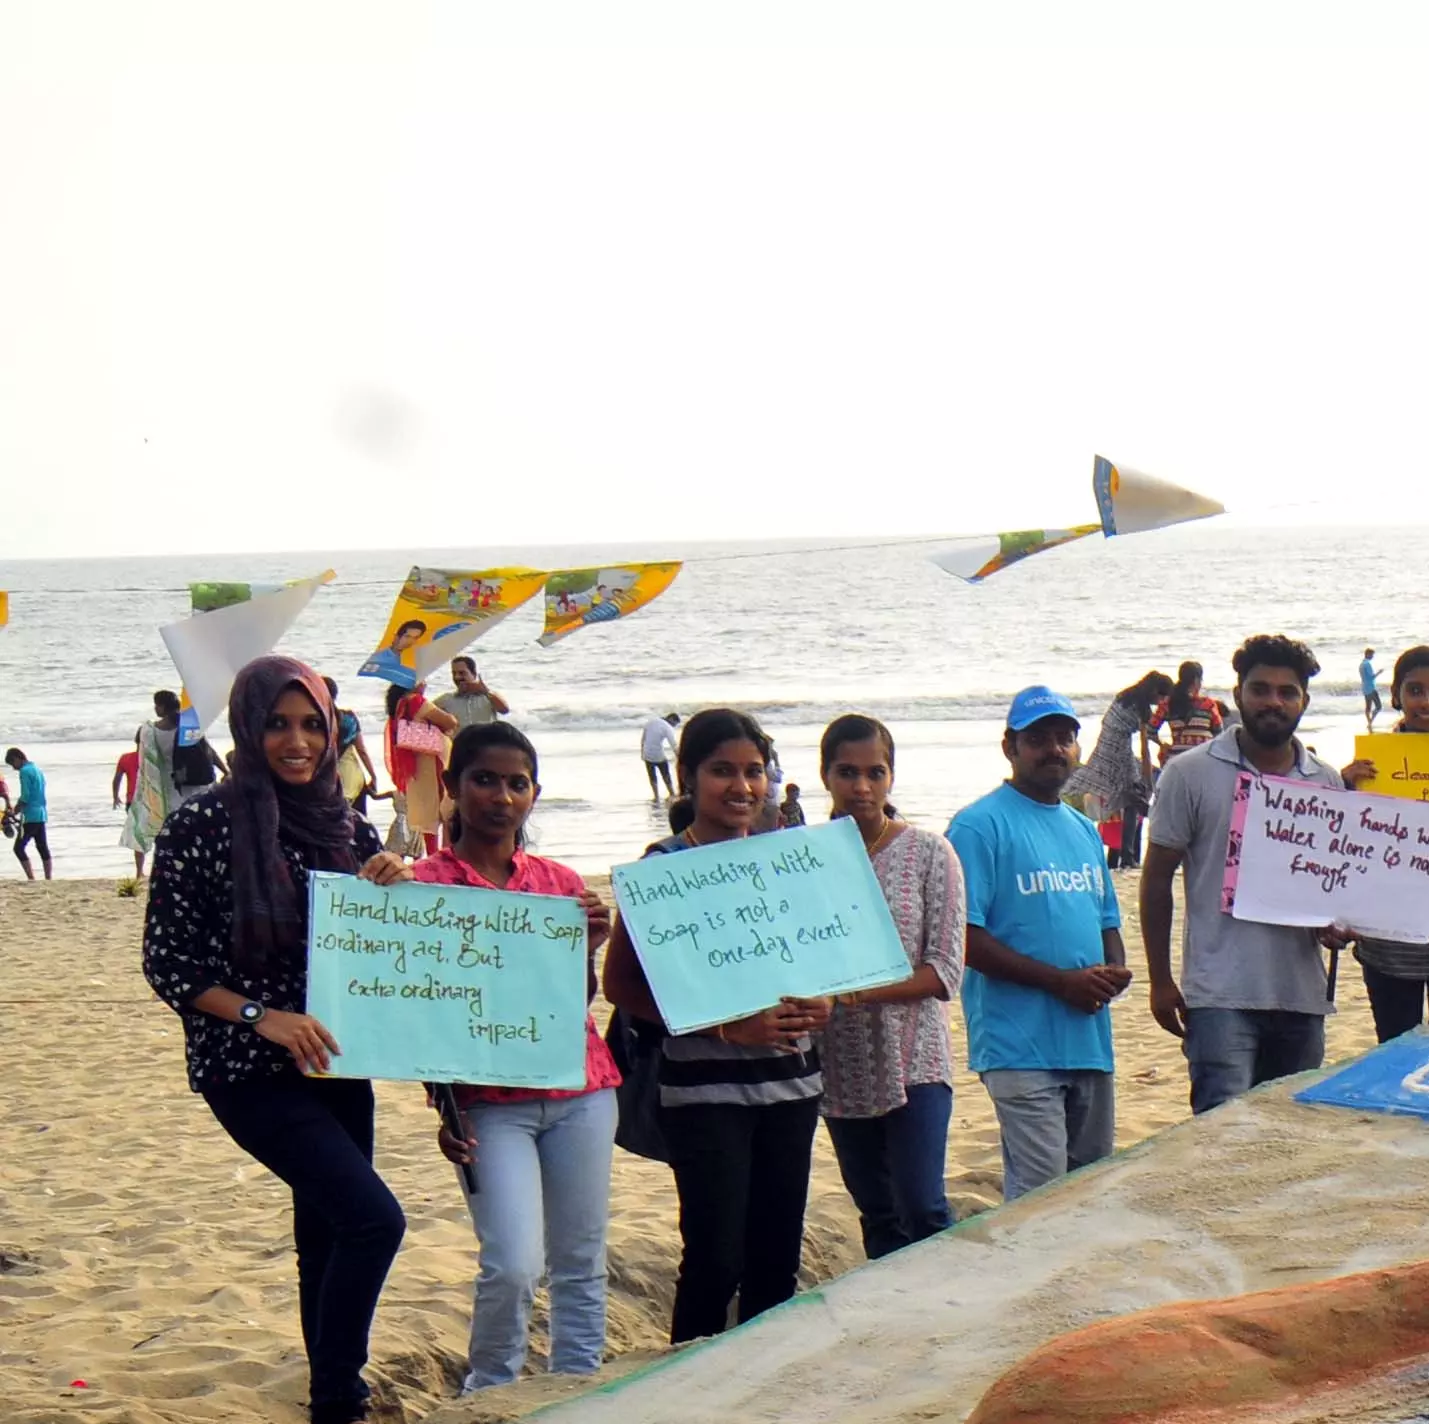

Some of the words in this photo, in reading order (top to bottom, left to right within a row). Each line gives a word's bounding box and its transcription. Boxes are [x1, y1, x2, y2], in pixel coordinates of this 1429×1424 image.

[1360, 807, 1408, 840] hands
[1328, 834, 1374, 859] alone
[1384, 846, 1400, 869] is
[1016, 861, 1093, 896] unicef
[703, 910, 726, 932] is
[735, 896, 775, 925] not
[779, 900, 790, 913] a
